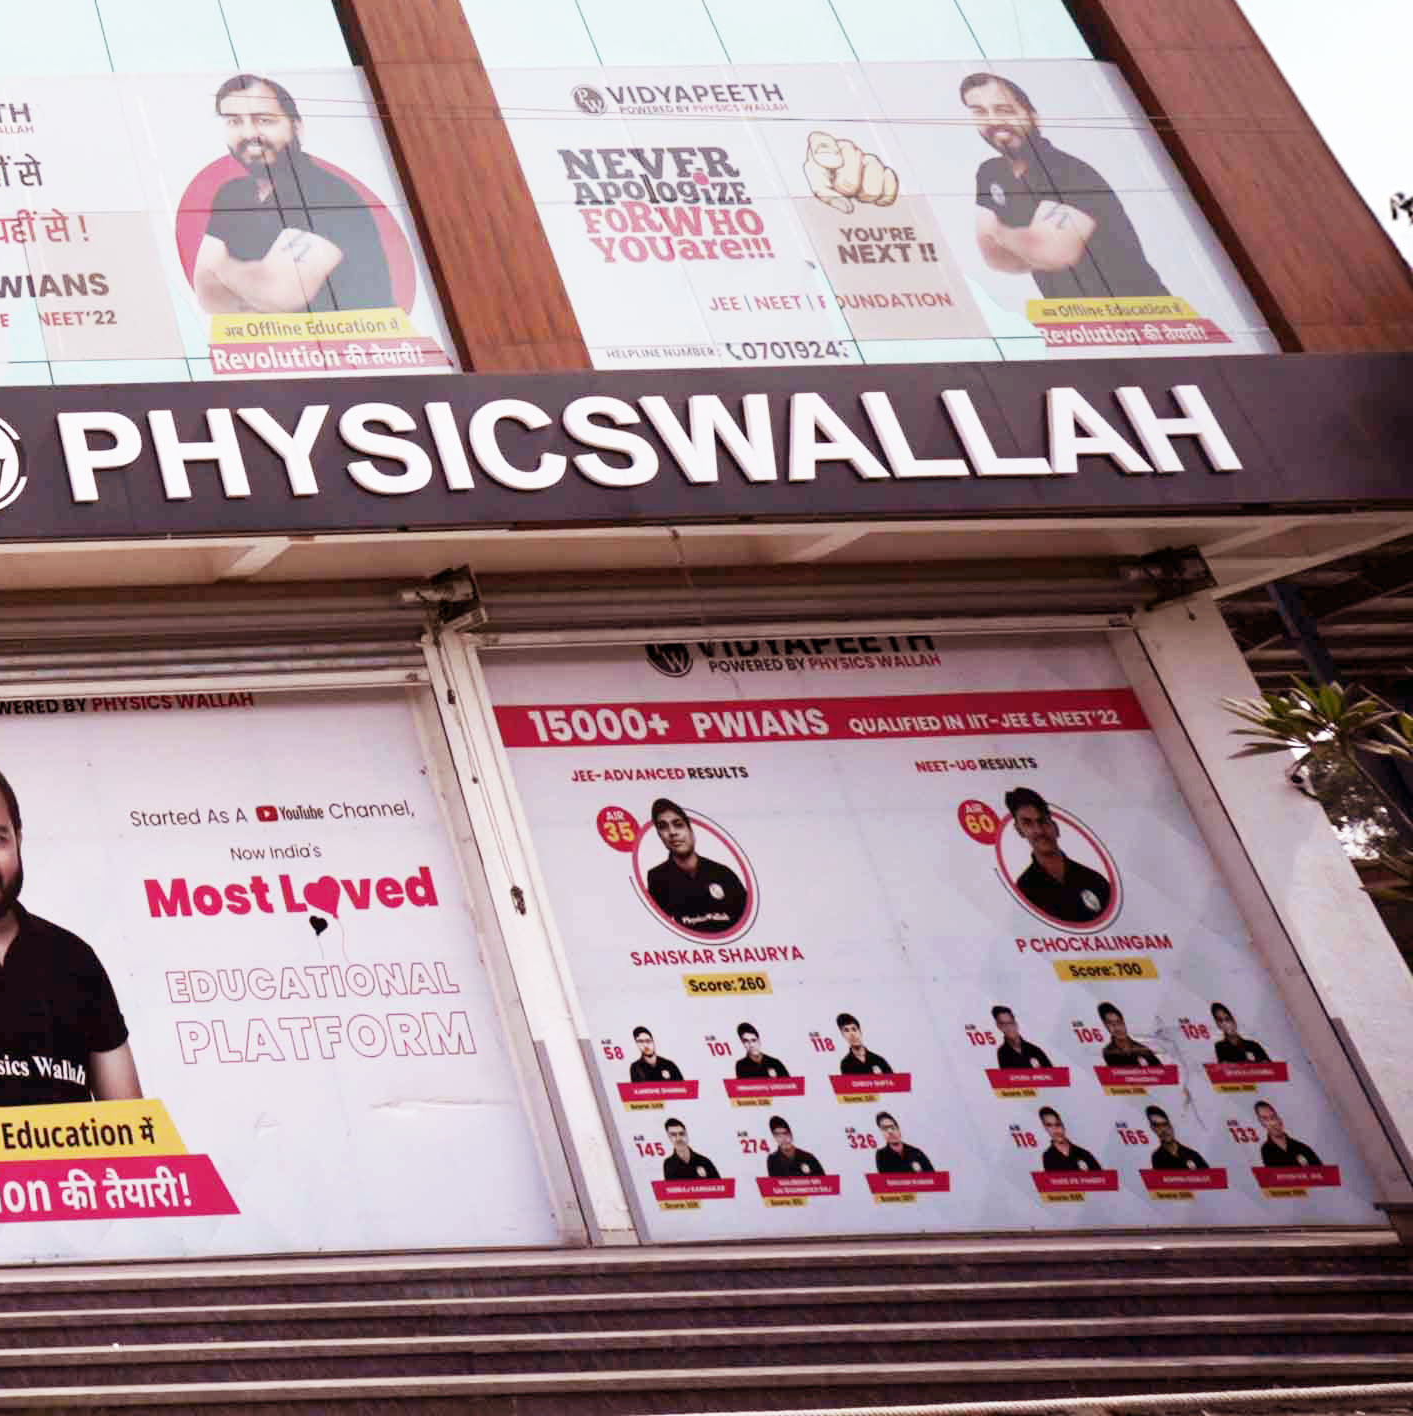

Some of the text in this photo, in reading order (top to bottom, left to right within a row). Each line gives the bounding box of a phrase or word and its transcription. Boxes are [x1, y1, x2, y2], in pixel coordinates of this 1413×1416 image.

[605, 84, 785, 105] VIDYAPEETH
[620, 103, 739, 114] POWERED PHYSICS
[14, 154, 43, 186] से
[557, 147, 740, 180] NEVER
[40, 208, 70, 243] से
[840, 227, 917, 241] YOU'RE
[838, 244, 911, 264] NEXT
[709, 296, 802, 312] JEE NEET
[246, 319, 386, 337] Offline Education
[213, 346, 341, 371] Revolution
[57, 384, 1243, 504] PHYSICSWALLAH
[709, 654, 941, 673] POWERED BY PHYSICS WALLAH
[64, 698, 86, 713] BY
[92, 694, 172, 712] PHYSICS
[176, 692, 254, 710] WALLAH
[528, 708, 1121, 742] 15000+ PWIANS QUALIFIED IN IIT-JEE NEET'22
[571, 765, 749, 782] JEE-ADVANCED RESULTS
[915, 756, 1039, 773] NEET-UG RESULTS
[129, 799, 416, 827] Started As A YouTube Channel,
[604, 822, 635, 842] 35
[965, 814, 995, 834] 60
[229, 842, 322, 862] Now India's
[143, 873, 271, 919] Most
[1015, 935, 1173, 952] P CHOCKALINGAM
[630, 945, 805, 966] SANSKAR SHAURYA
[1069, 963, 1143, 977] Score: 700
[165, 962, 461, 1004] EDUCATIONAL
[688, 977, 766, 993] Score: 260
[176, 1011, 478, 1066] PLATFORM
[810, 1038, 835, 1053] 118
[966, 1031, 997, 1046] 105
[603, 1046, 625, 1060] 58
[707, 1042, 733, 1057] 101
[2, 1119, 133, 1151] Education
[139, 1117, 155, 1147] में
[847, 1135, 878, 1149] 326
[635, 1142, 666, 1157] 145
[740, 1139, 770, 1154] 274
[59, 1171, 98, 1211] की
[104, 1172, 190, 1211] तैयारी!
